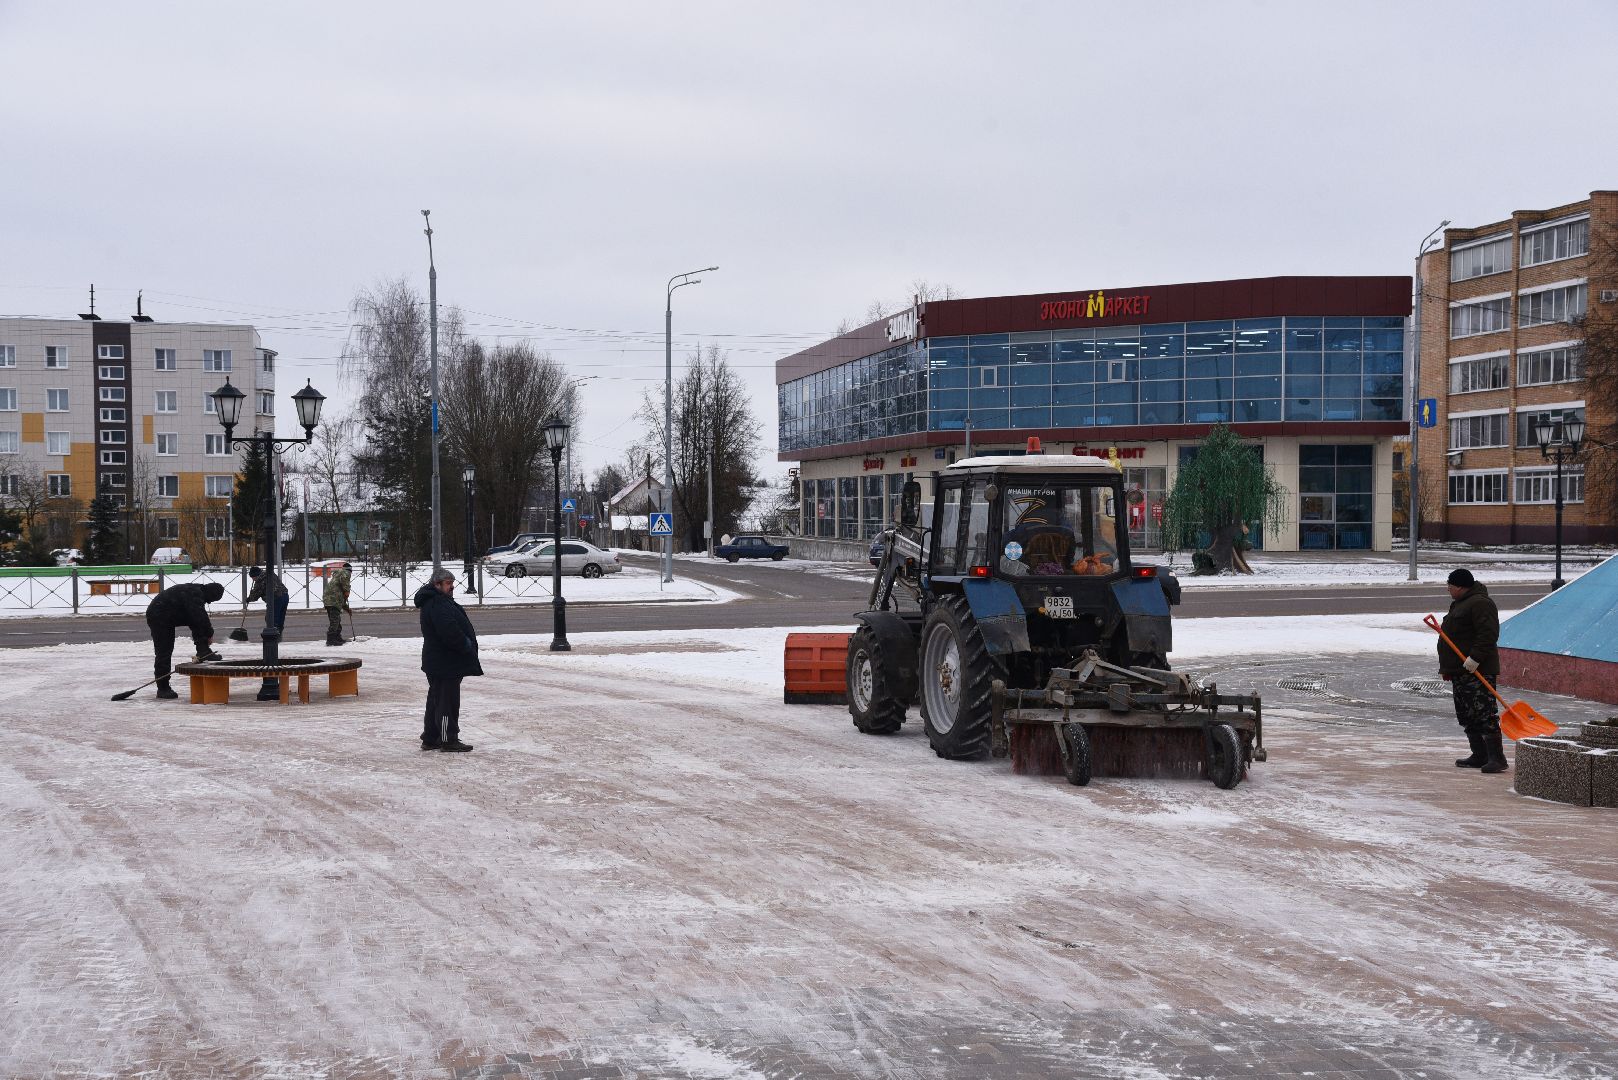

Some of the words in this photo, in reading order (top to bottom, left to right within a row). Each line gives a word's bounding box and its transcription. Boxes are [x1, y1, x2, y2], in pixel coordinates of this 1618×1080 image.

[1040, 290, 1151, 320] ЭКОНОМАРКЕТ
[1089, 446, 1146, 460] МАНИТ
[1047, 597, 1071, 607] 9832
[1062, 609, 1072, 618] 50
